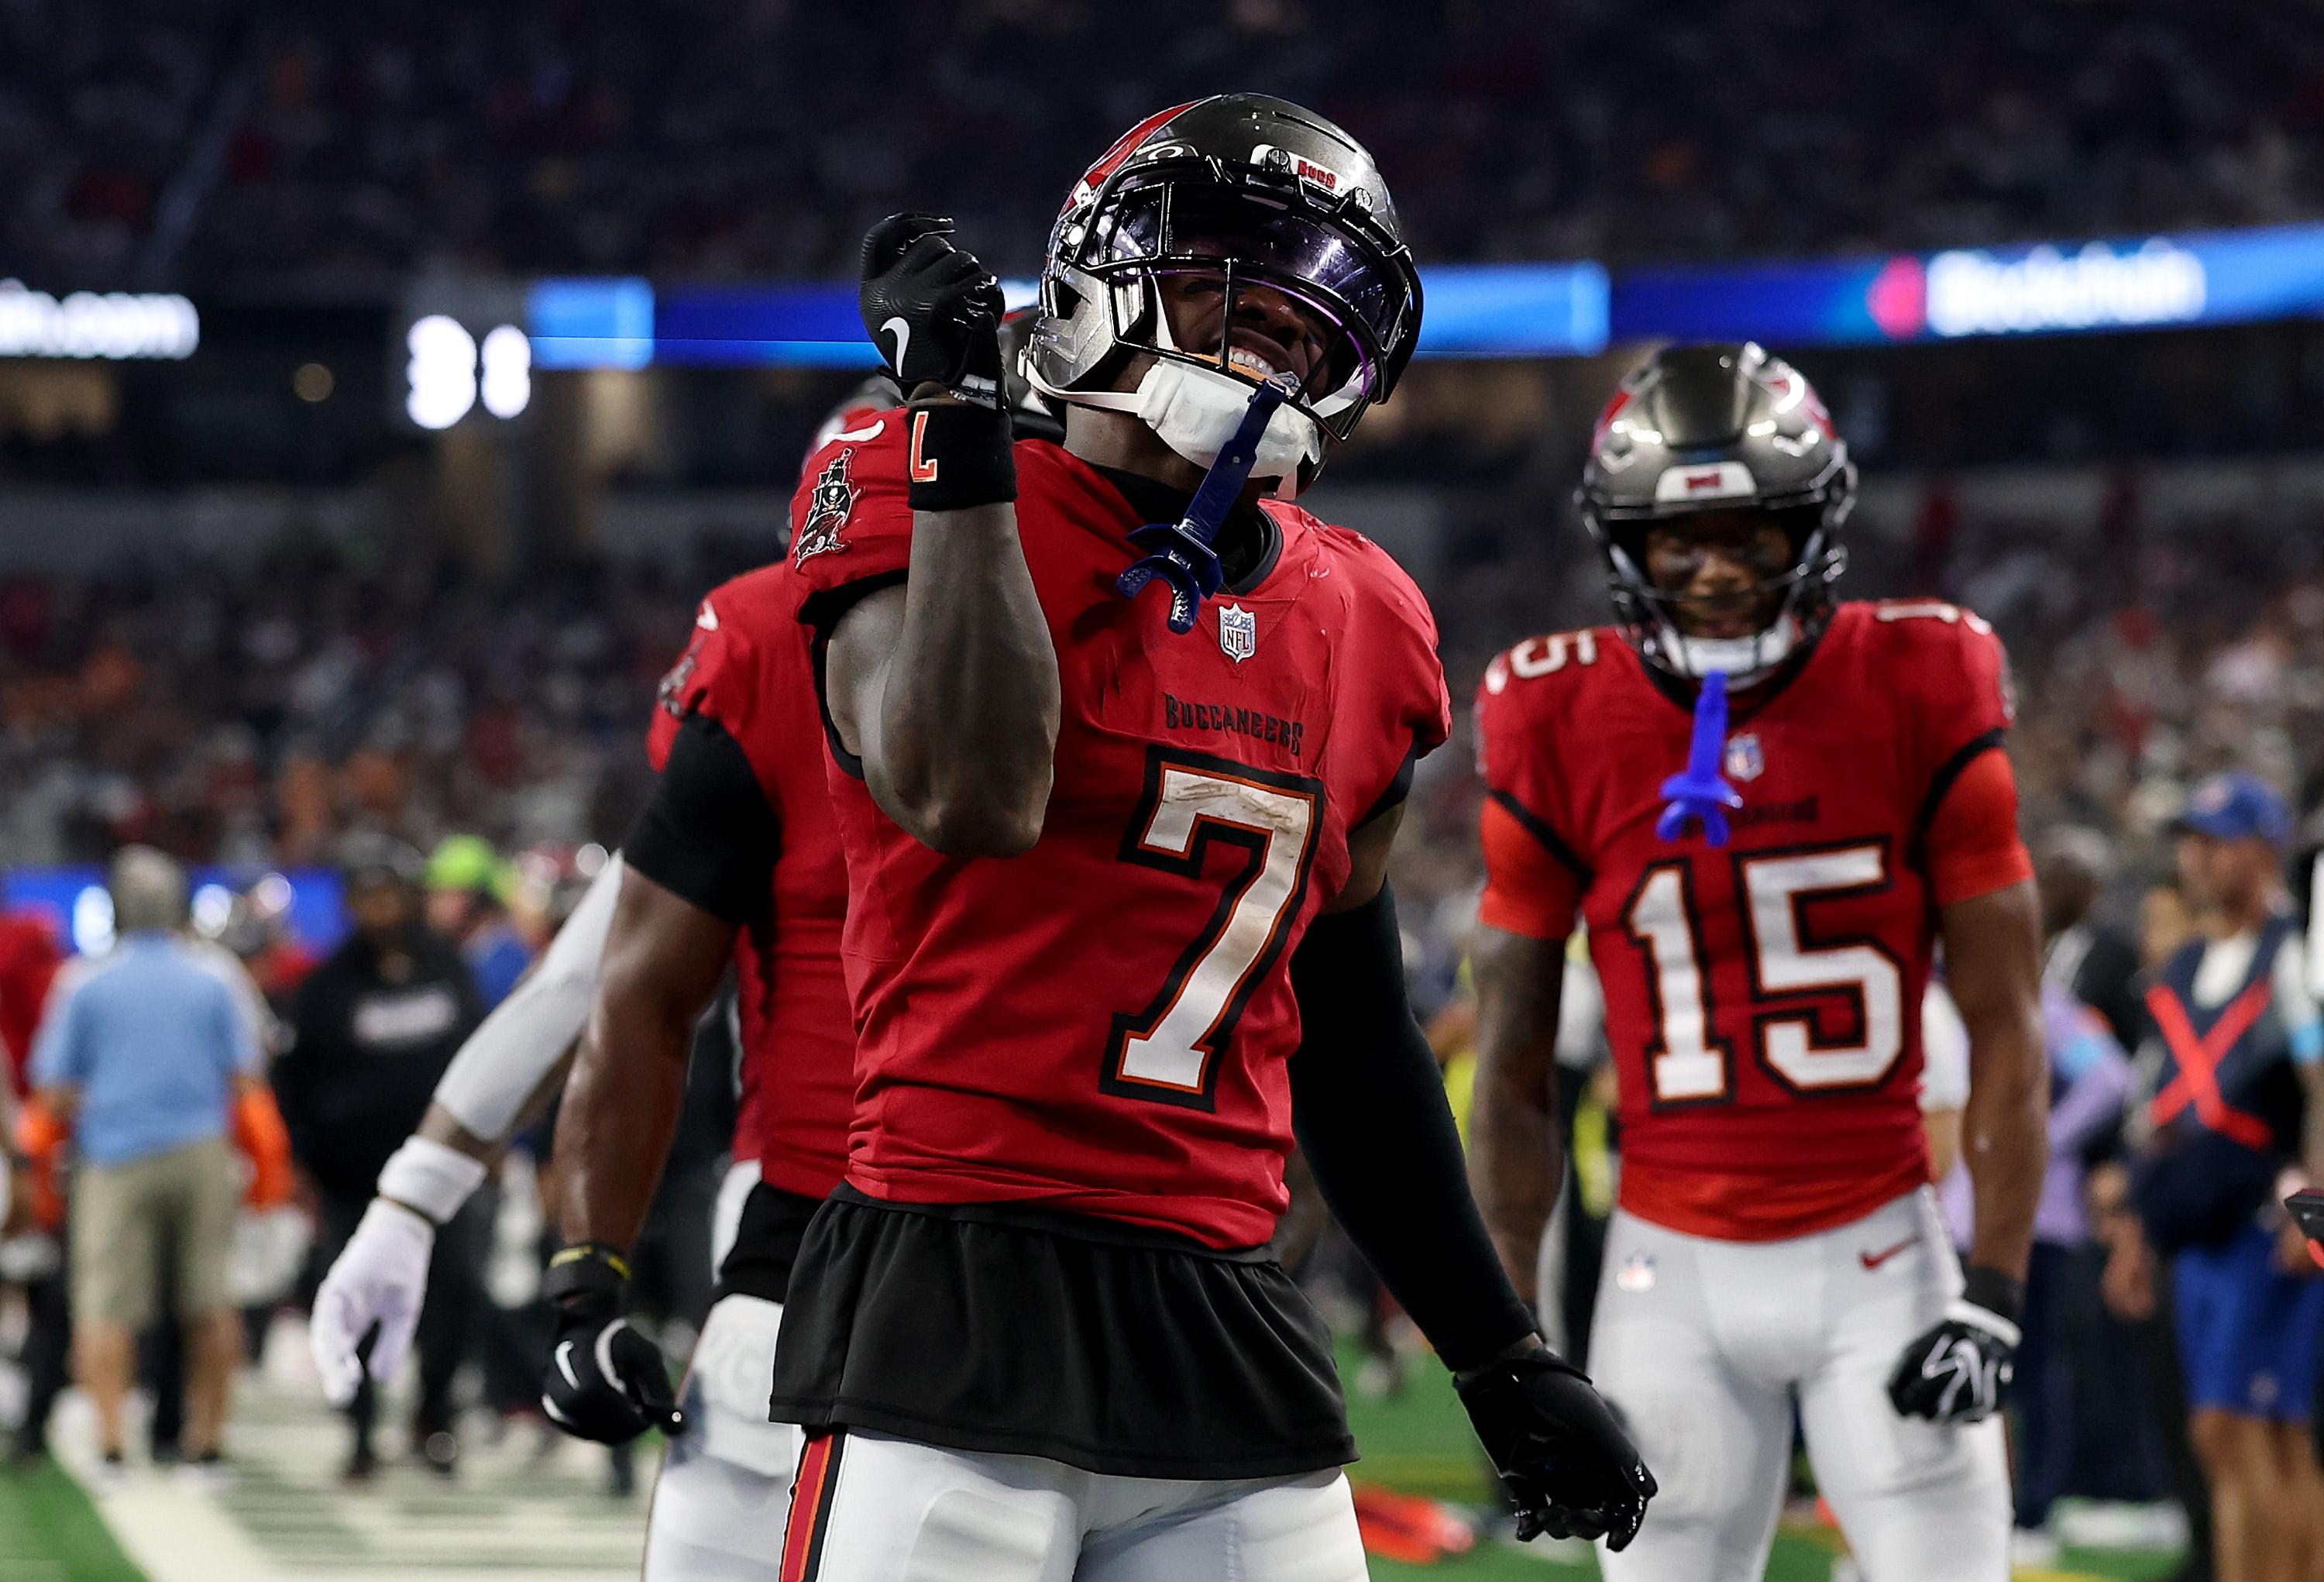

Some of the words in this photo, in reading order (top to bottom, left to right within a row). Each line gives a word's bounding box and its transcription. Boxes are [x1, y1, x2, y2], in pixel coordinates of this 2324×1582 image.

[1164, 693, 1305, 757] BUCCANEERS
[1226, 628, 1250, 651] NFL
[1099, 744, 1325, 1113] 7
[1621, 833, 1906, 1116] 15
